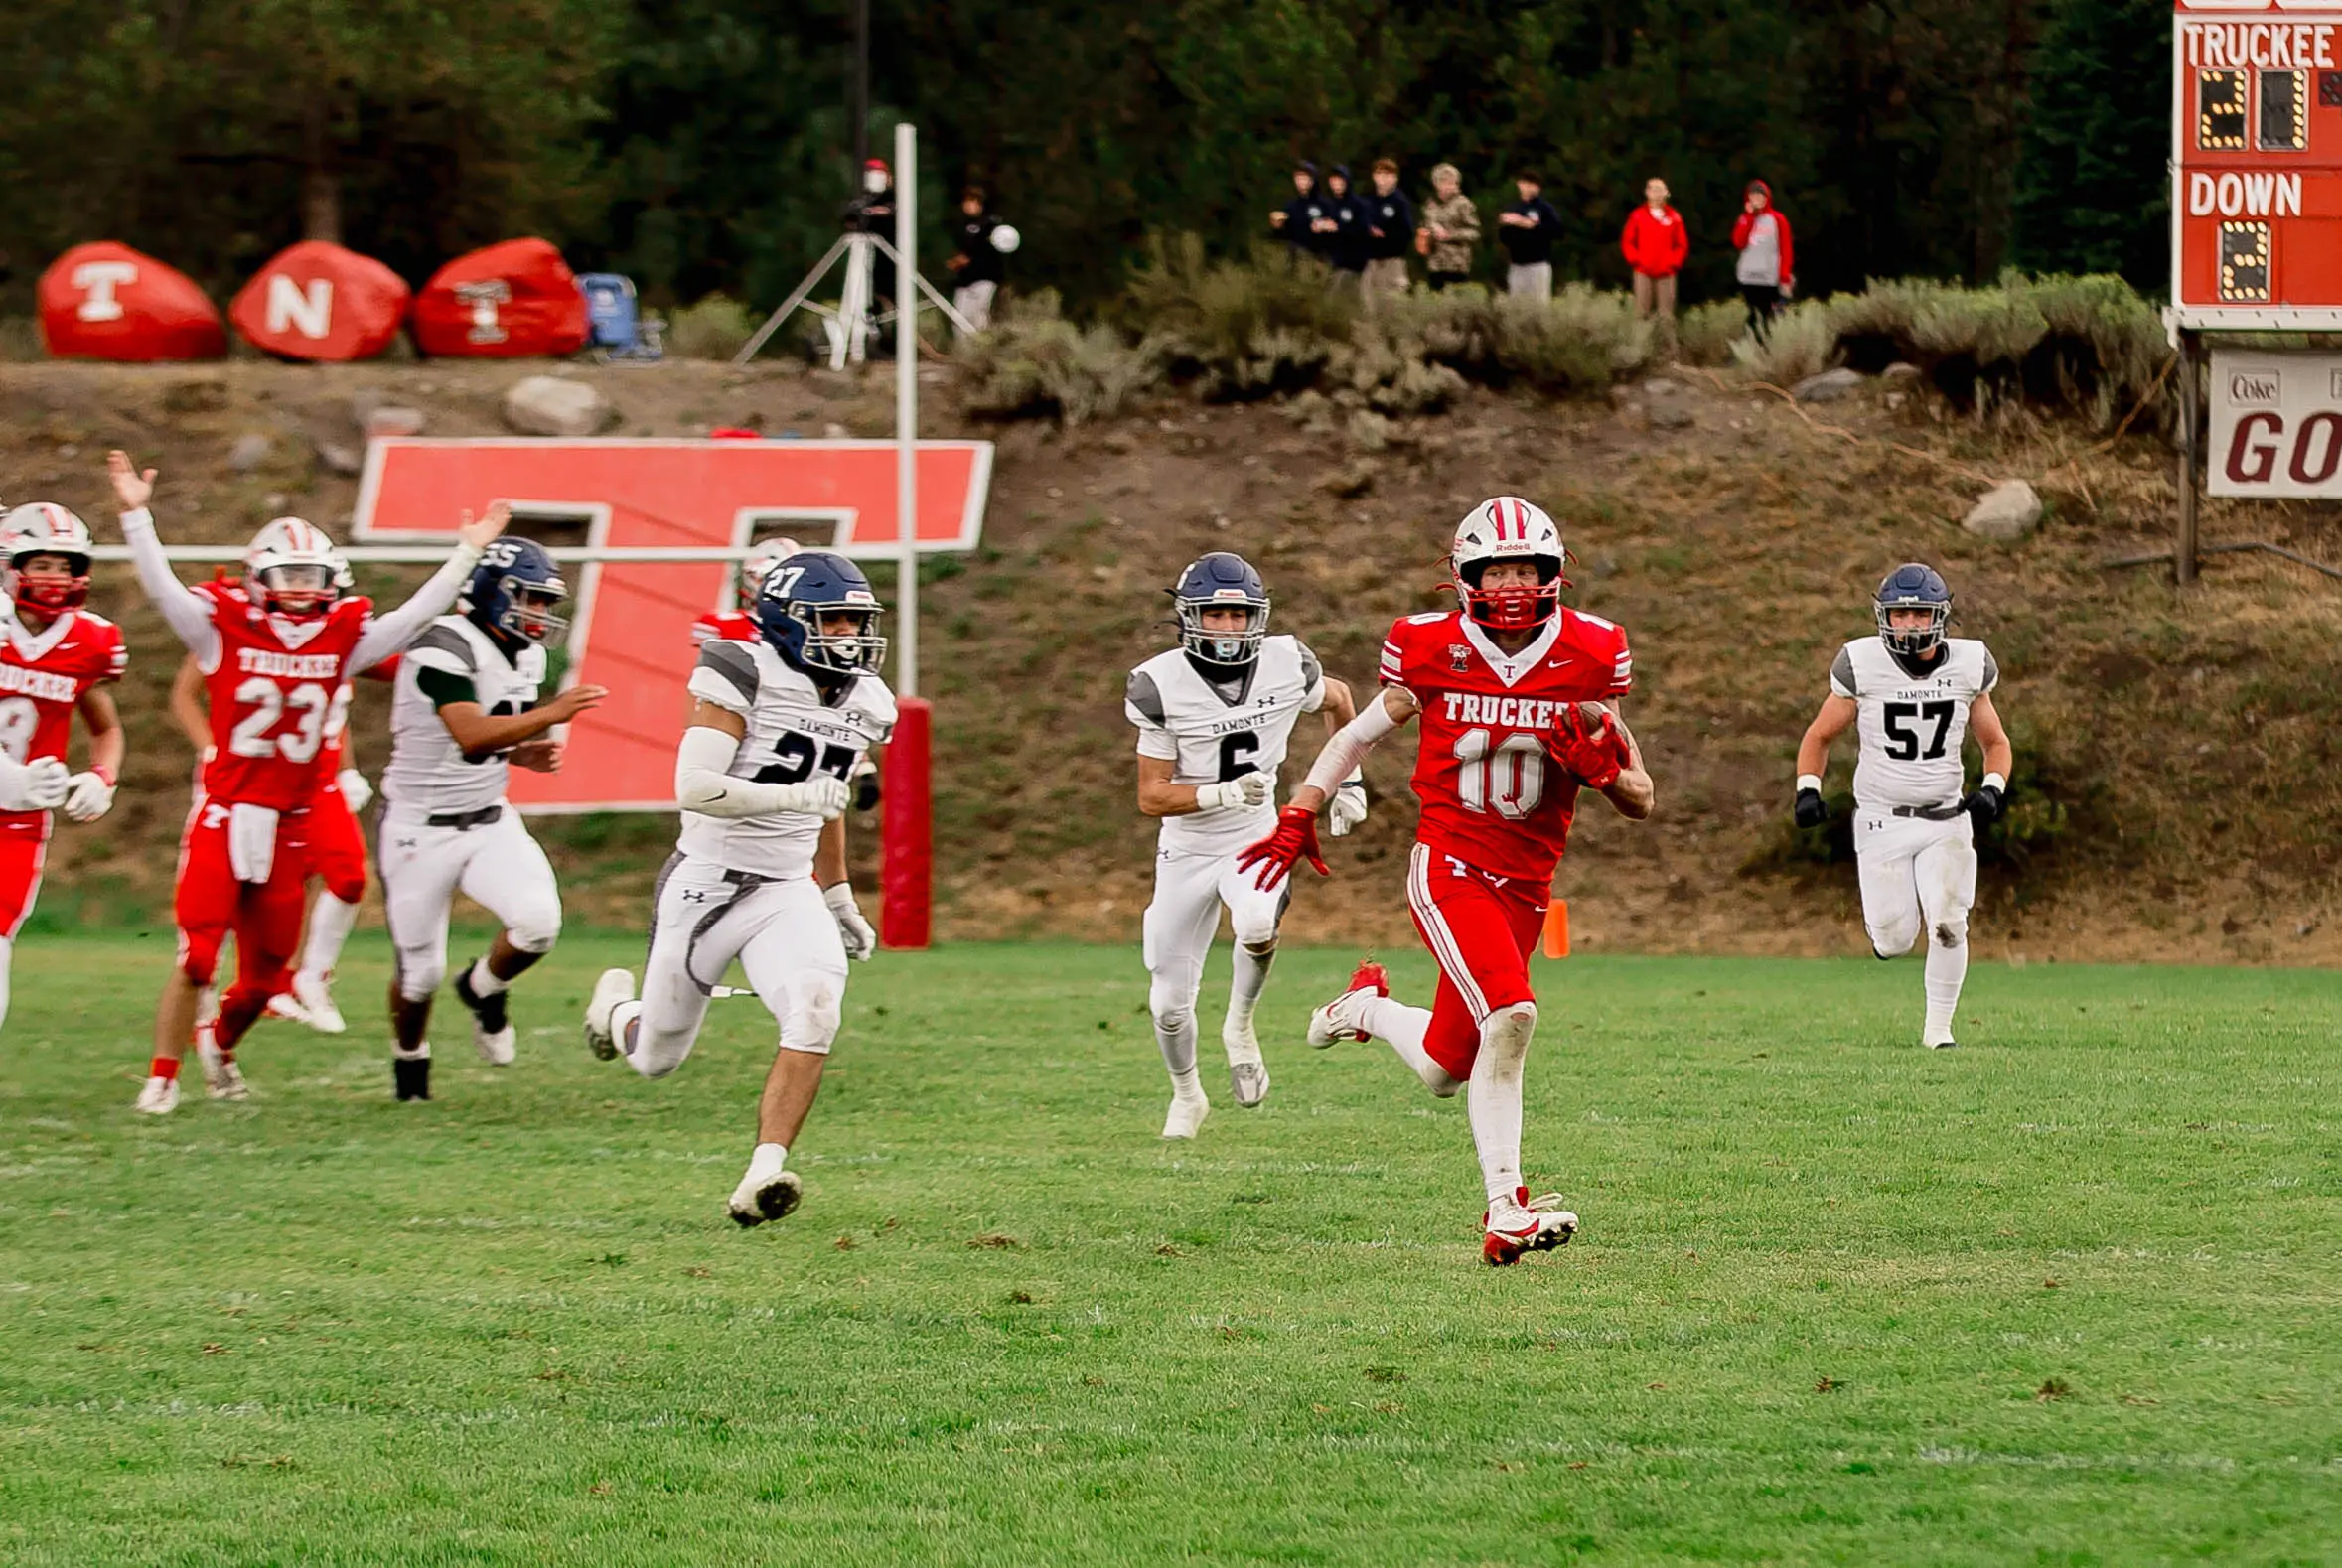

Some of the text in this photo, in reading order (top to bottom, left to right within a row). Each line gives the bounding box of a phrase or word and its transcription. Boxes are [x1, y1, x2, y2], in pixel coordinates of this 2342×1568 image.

[2185, 24, 2335, 68] TRUCKEE
[2190, 173, 2301, 216] DOWN
[2222, 221, 2268, 300] 2
[72, 263, 138, 321] T
[267, 275, 333, 338] N
[2232, 374, 2276, 400] Coke
[2225, 412, 2342, 484] GO
[764, 567, 806, 598] 27
[237, 647, 340, 679] TRUCKEE
[1504, 664, 1516, 679] T
[1897, 690, 1943, 700] DAMONTE
[229, 677, 330, 763] 23
[1212, 714, 1265, 735] DAMONTE
[1884, 699, 1955, 761] 57
[1454, 728, 1546, 819] 10
